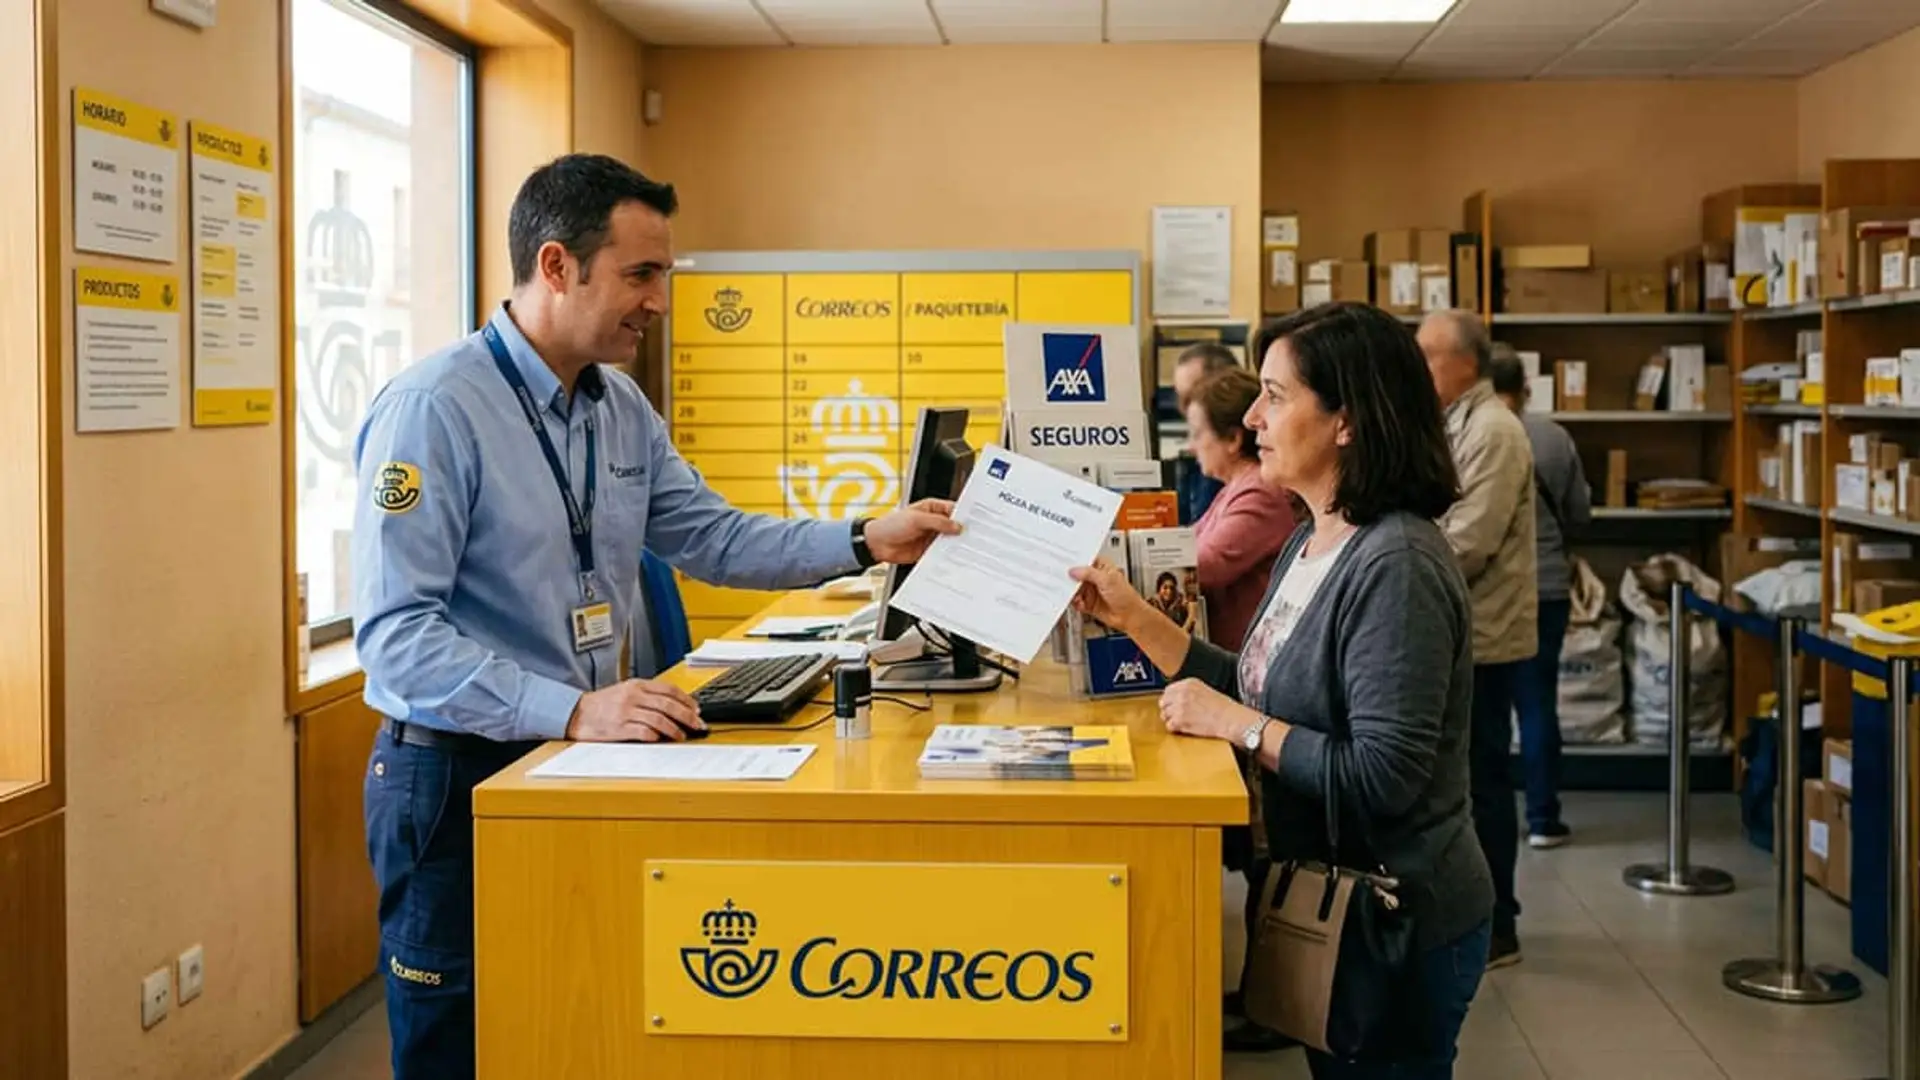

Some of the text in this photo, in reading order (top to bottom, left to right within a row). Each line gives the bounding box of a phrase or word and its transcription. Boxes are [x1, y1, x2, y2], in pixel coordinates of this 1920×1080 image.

[795, 297, 892, 318] CORREOS
[914, 299, 1009, 319] PAQUETERÍA
[1047, 368, 1096, 396] AXA
[1030, 425, 1130, 447] SEGUROS
[790, 936, 1095, 1002] CORREOS
